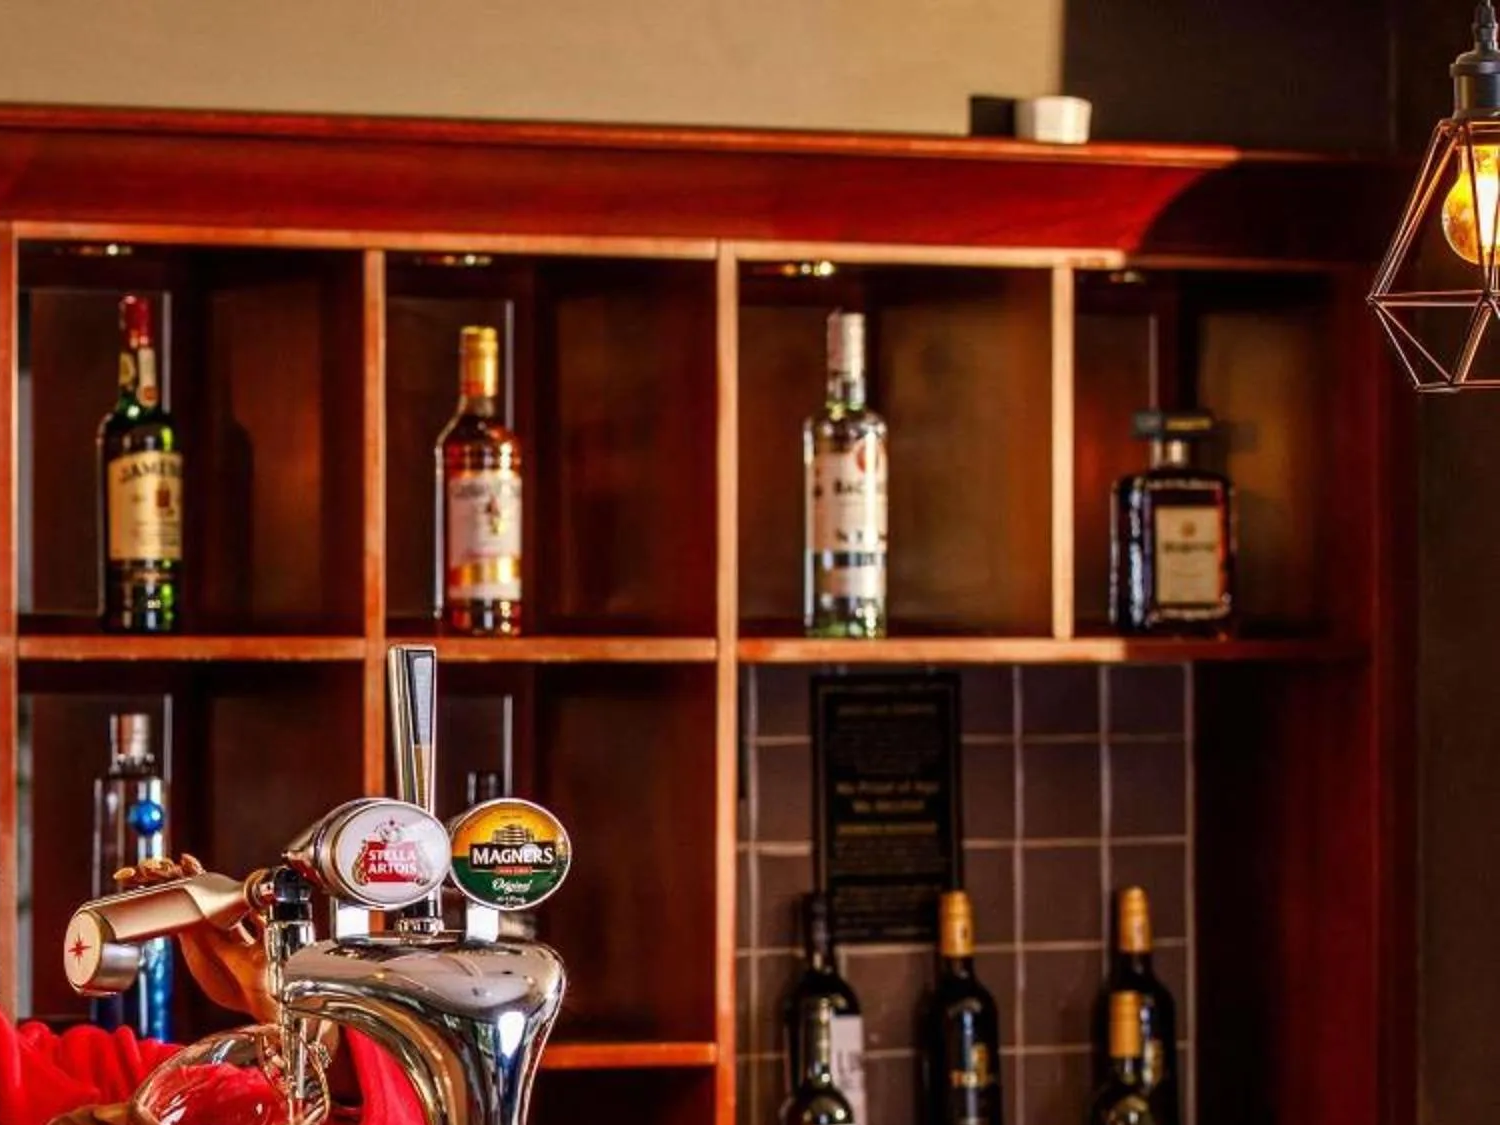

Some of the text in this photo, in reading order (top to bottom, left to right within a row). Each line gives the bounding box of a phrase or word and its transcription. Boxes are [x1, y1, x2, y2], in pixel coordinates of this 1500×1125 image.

[368, 849, 416, 860] STELLA
[472, 847, 554, 865] MAGNERS
[368, 863, 417, 874] ARTOIS
